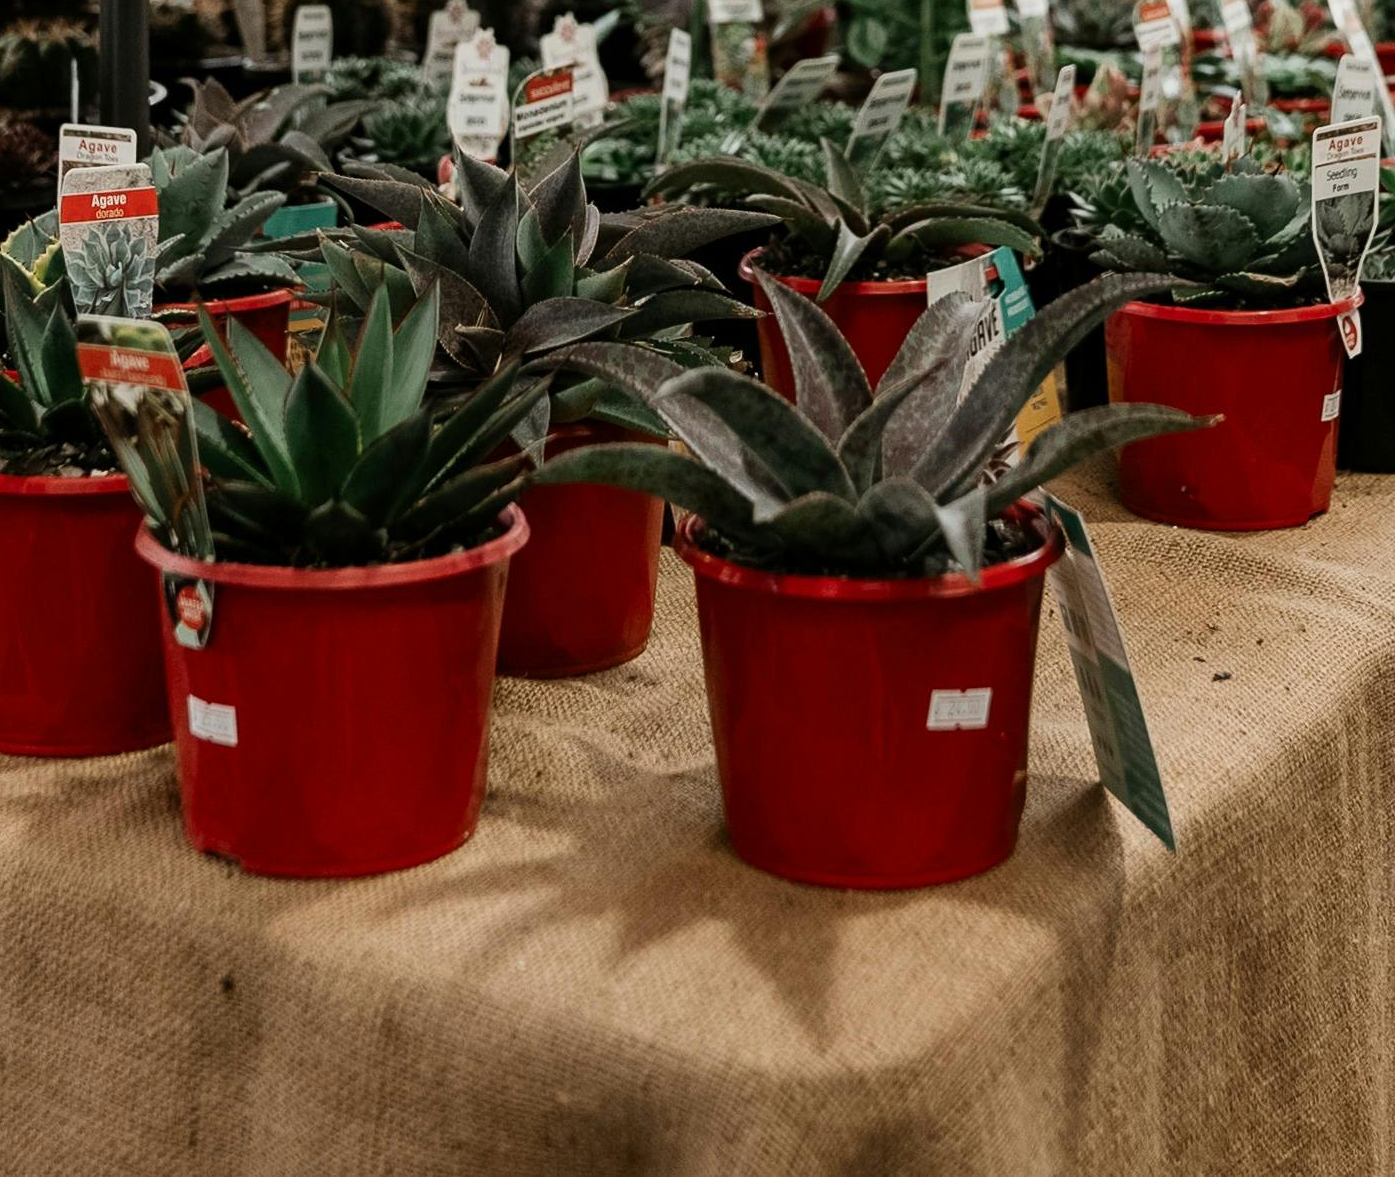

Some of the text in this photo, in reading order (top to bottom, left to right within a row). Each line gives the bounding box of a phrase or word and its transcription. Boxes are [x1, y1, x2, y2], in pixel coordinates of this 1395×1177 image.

[78, 139, 117, 154] Agave
[1328, 135, 1363, 152] Agave
[1326, 166, 1358, 182] Seedling
[1331, 183, 1349, 193] Form
[91, 194, 127, 209] Agave
[95, 208, 125, 219] dorado
[109, 349, 150, 372] Agave
